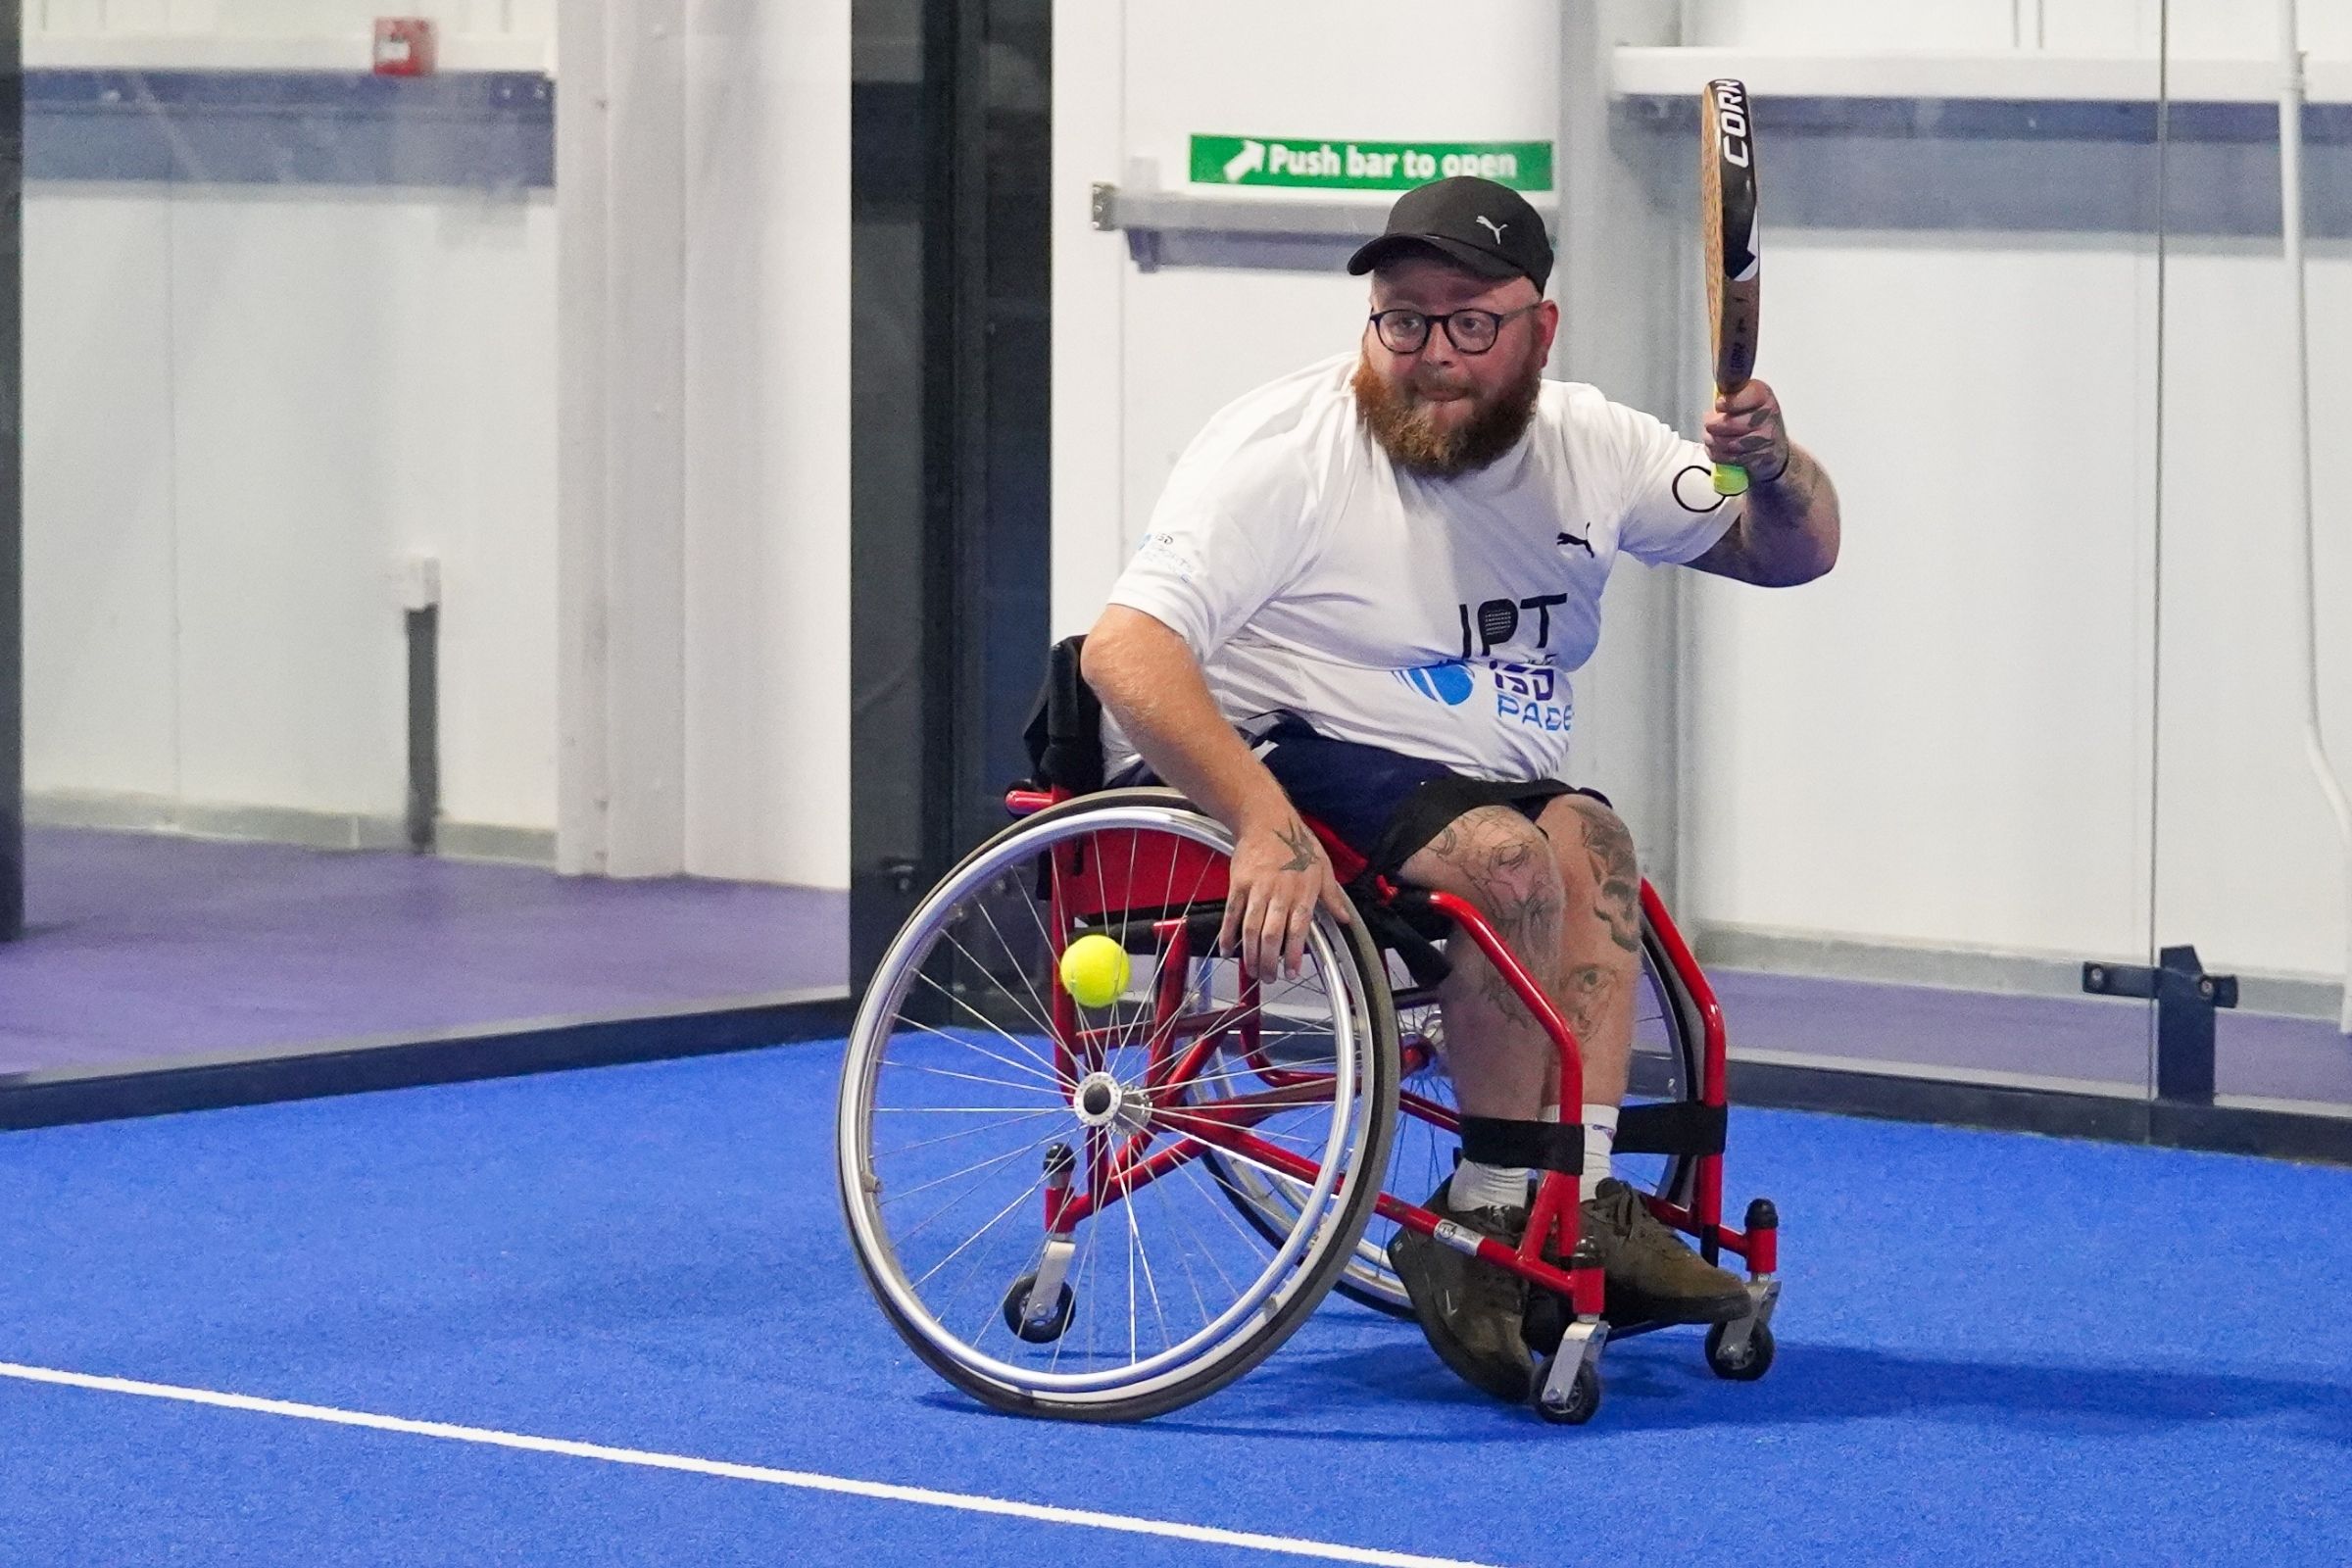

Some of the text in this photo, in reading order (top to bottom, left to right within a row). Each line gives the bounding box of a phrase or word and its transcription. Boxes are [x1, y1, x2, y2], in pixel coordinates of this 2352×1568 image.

[1269, 144, 1518, 179] Push bar to open
